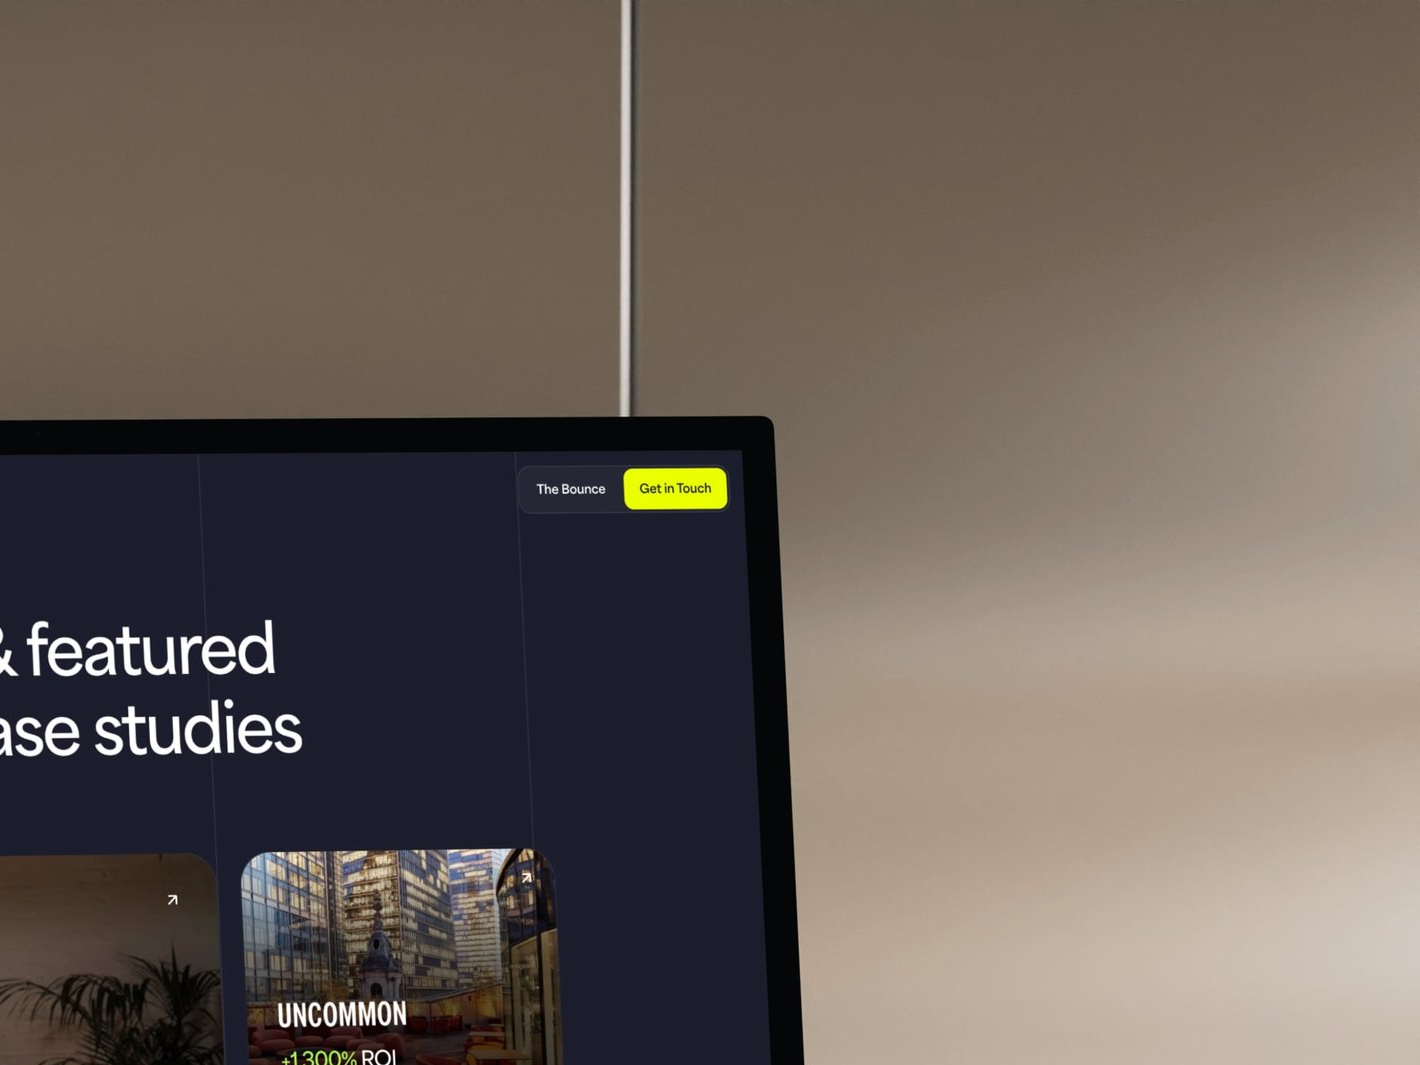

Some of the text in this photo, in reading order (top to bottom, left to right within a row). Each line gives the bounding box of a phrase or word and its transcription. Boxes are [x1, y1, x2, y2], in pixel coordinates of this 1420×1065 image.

[536, 483, 606, 495] The Bounce
[639, 482, 712, 495] Get in Touch
[27, 620, 275, 676] featured
[95, 699, 302, 755] studies
[278, 1001, 406, 1028] UNCOMMON
